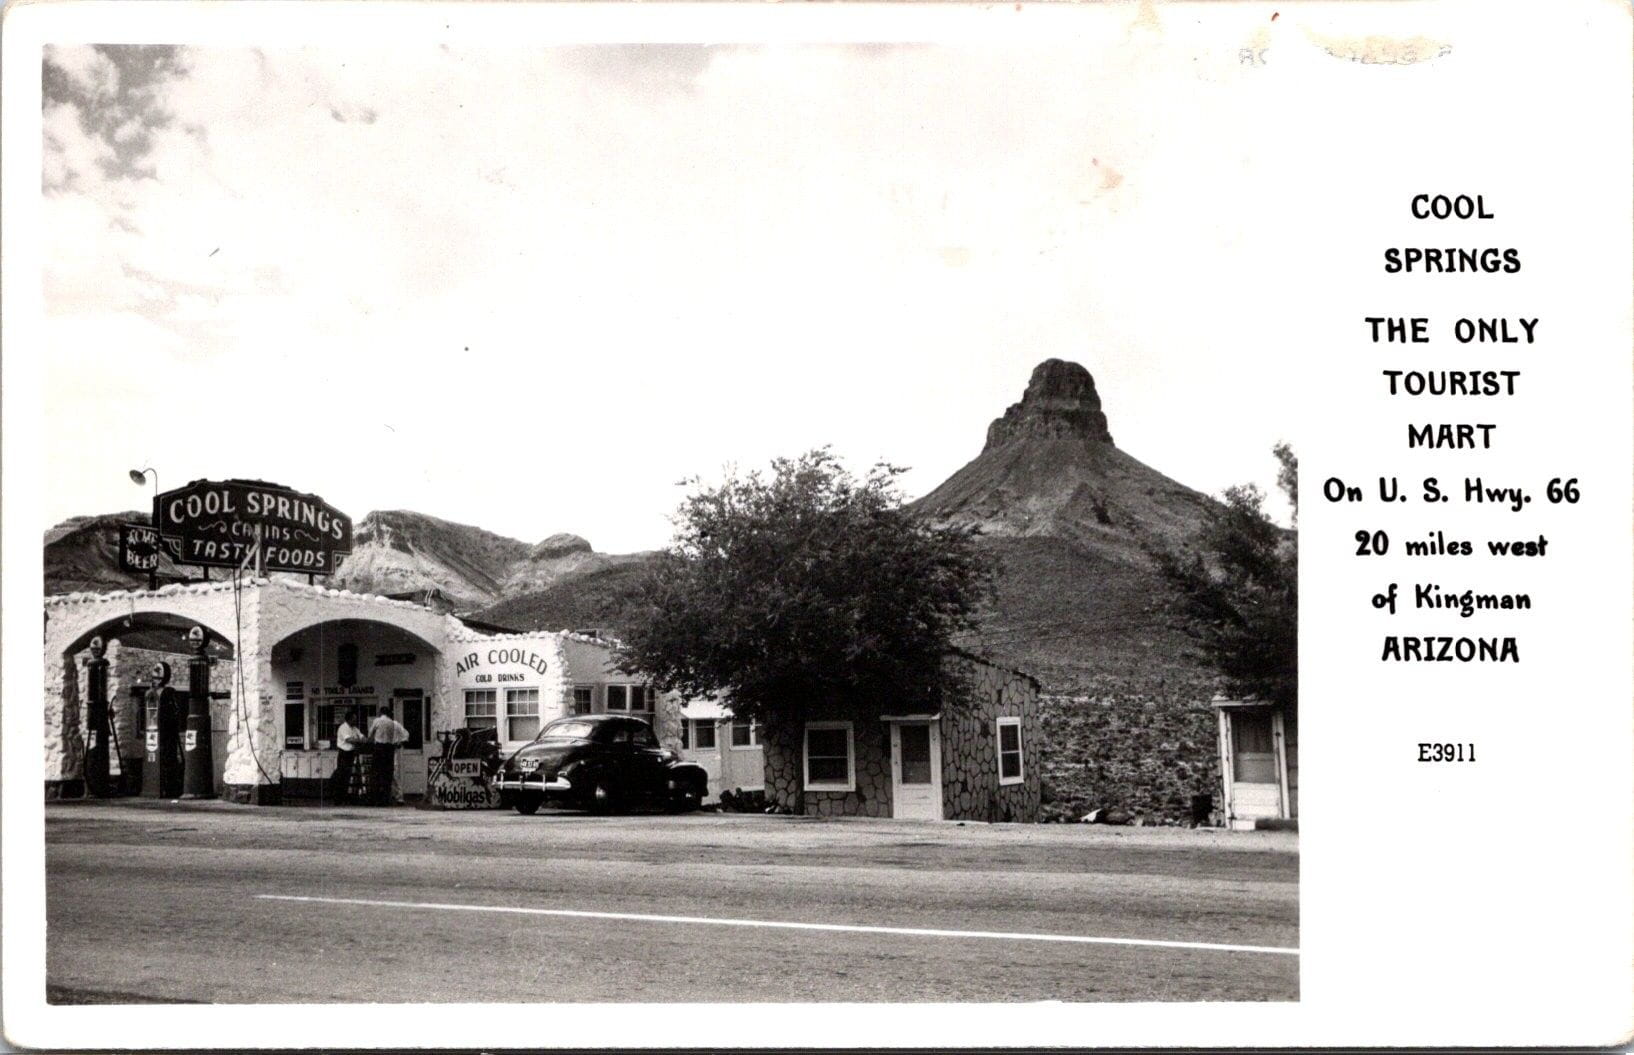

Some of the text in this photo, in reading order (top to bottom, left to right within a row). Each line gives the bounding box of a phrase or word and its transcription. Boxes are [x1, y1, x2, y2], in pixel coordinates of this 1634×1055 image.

[169, 491, 343, 540] COOL SPRINGS
[232, 521, 291, 540] CAINS
[126, 549, 158, 569] BEER
[265, 545, 326, 568] FOODS
[455, 648, 548, 677] AIR COOLED
[475, 673, 525, 683] COLD DRINKS
[454, 762, 479, 774] OPEN
[436, 784, 486, 808] Mobilgas
